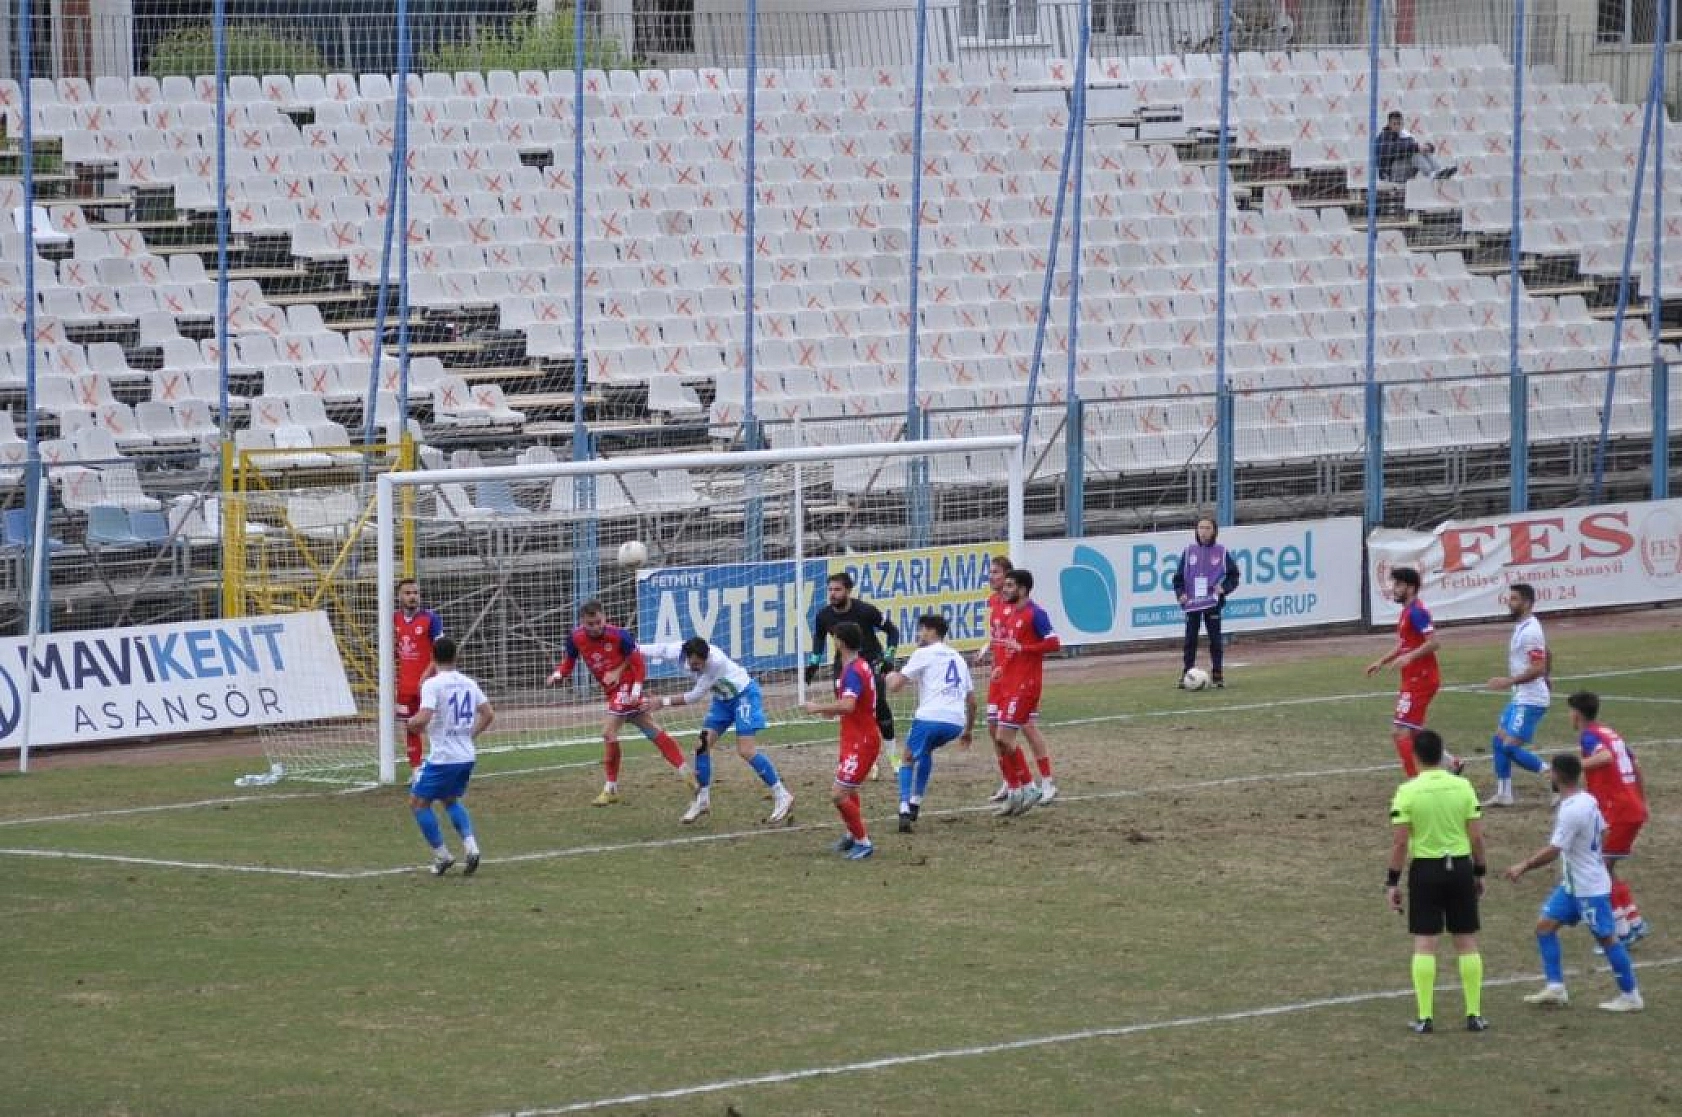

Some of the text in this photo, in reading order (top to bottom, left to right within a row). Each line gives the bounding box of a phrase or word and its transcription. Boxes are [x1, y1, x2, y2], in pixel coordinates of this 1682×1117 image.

[1433, 511, 1635, 573] FES
[844, 552, 990, 600] PAZARLAMA
[654, 581, 815, 660] AYTEK
[899, 599, 990, 645] MRKE
[1270, 594, 1317, 616] GRUP
[18, 623, 285, 693] MAVİKENT
[945, 659, 962, 688] 4
[74, 684, 283, 734] ASANSÖR
[448, 690, 473, 725] 14
